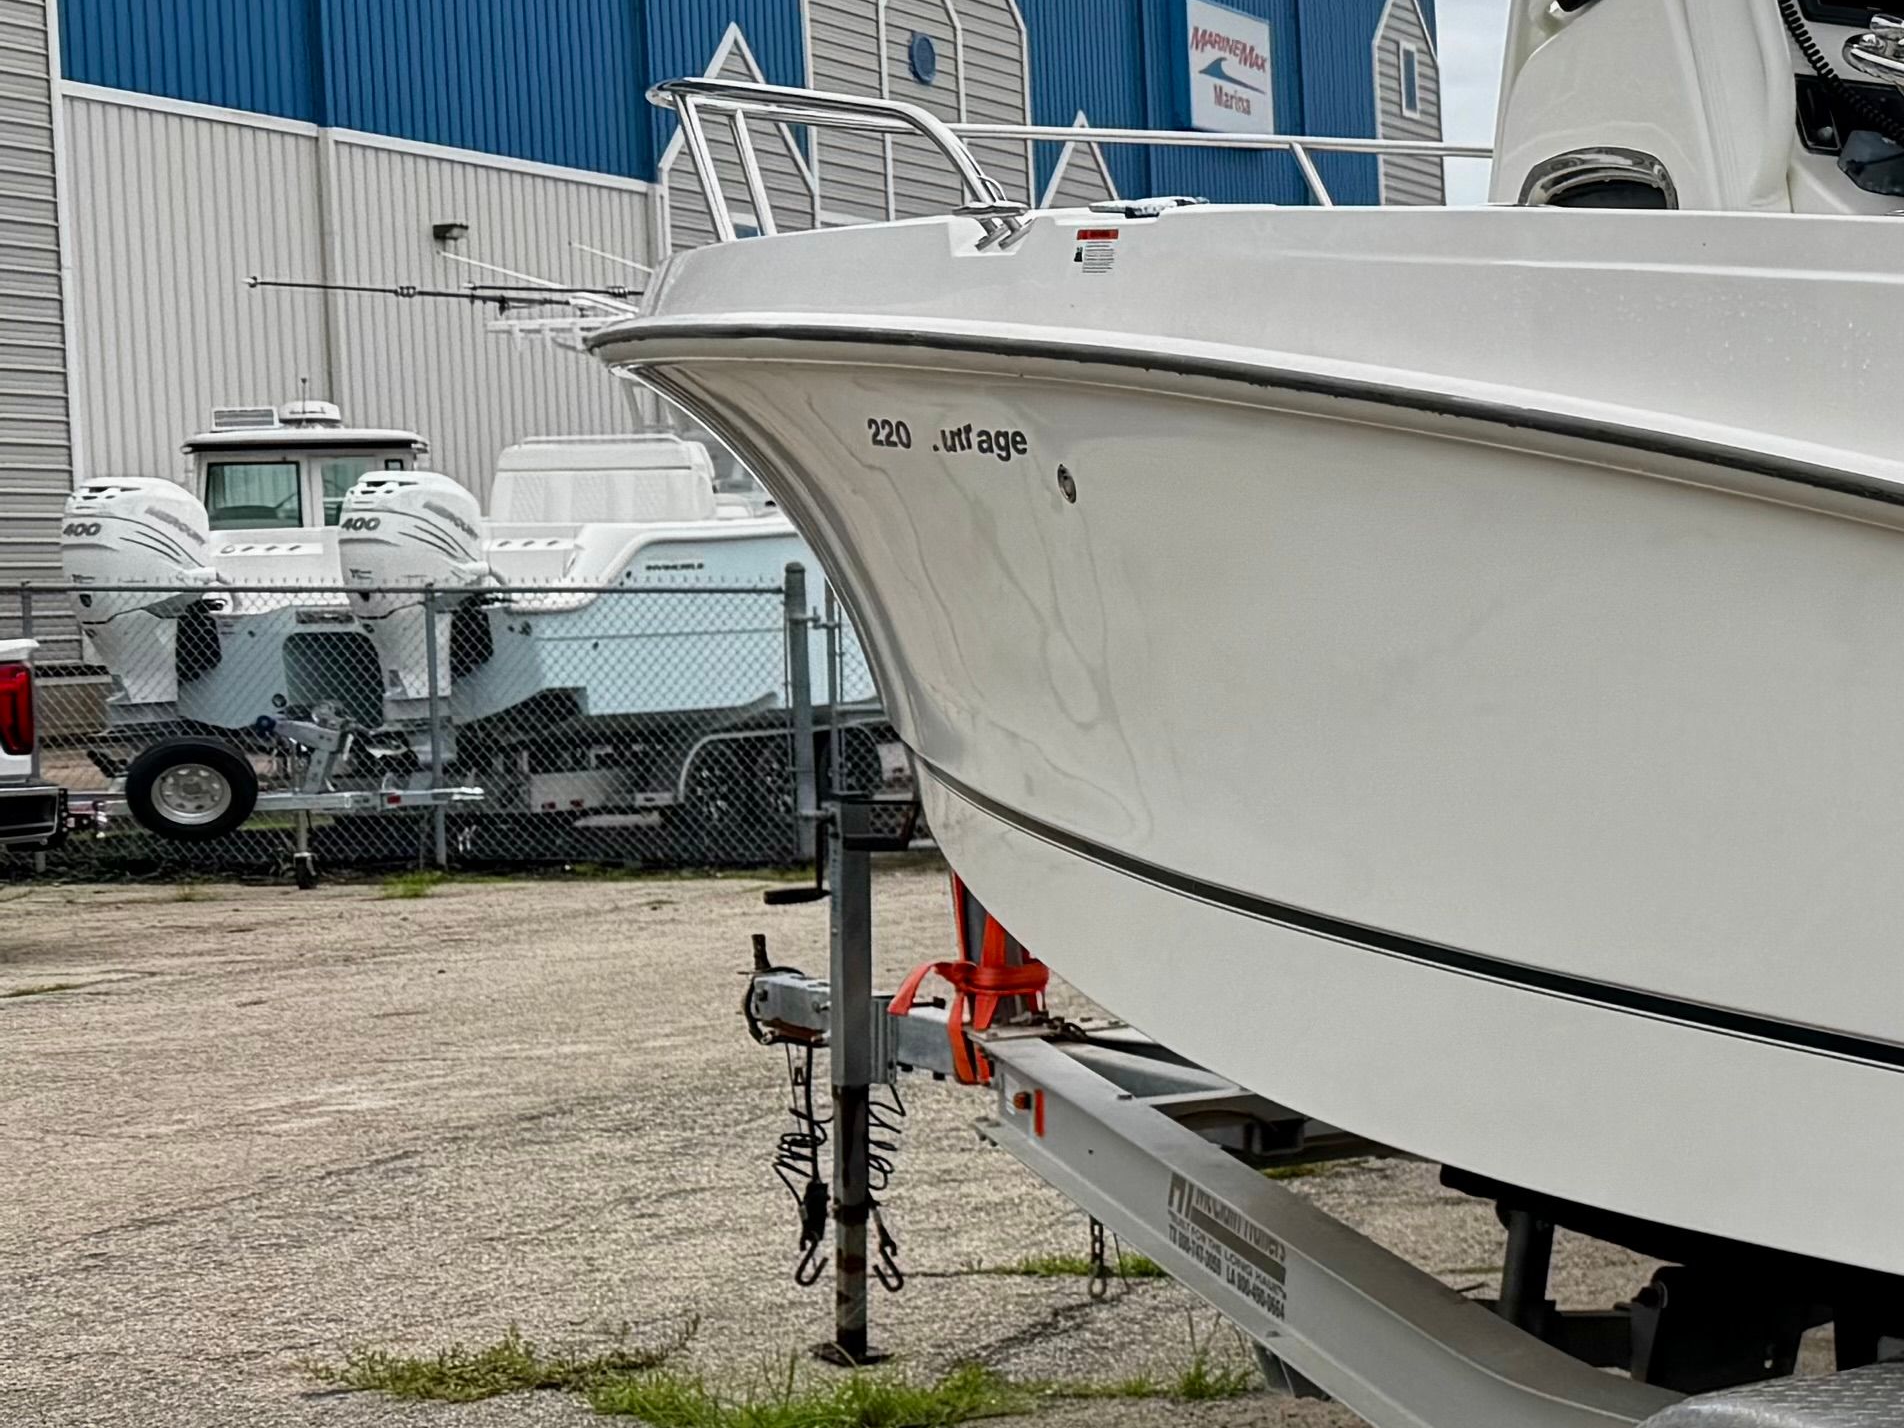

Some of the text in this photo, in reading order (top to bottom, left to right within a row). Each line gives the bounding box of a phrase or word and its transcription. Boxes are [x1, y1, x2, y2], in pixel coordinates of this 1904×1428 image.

[867, 418, 911, 449] 220
[62, 522, 101, 537] 400
[341, 517, 381, 532] 400
